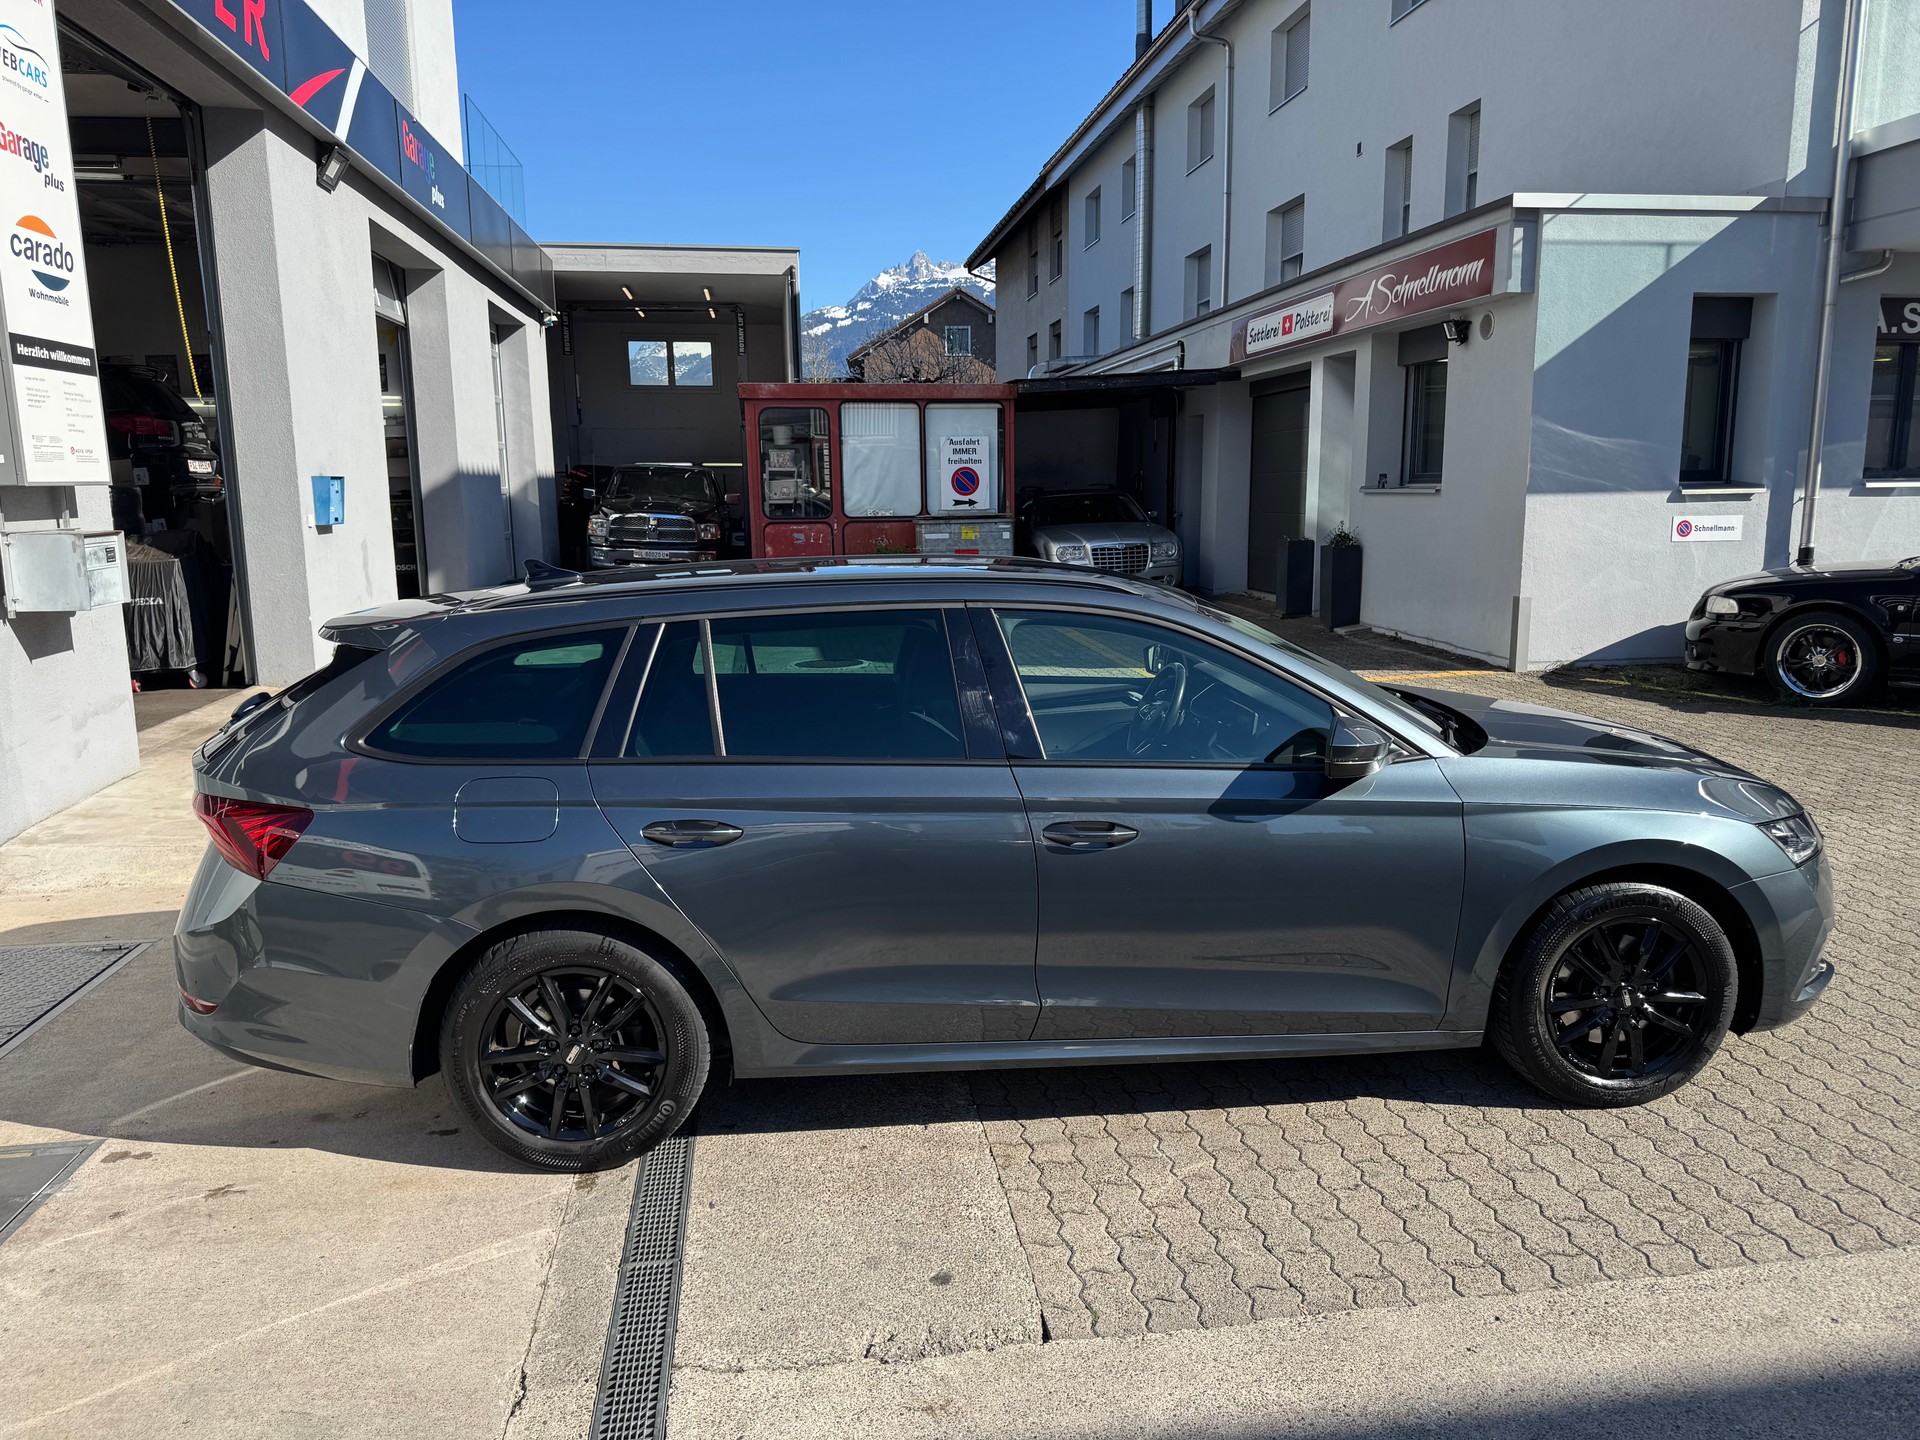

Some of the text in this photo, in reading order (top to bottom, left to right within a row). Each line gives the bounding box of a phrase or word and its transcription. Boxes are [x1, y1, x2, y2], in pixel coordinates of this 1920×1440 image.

[0, 46, 47, 88] EBCARS
[0, 121, 49, 174] Garage
[402, 119, 435, 185] Garage
[44, 172, 65, 192] plus
[431, 184, 444, 209] plus
[10, 233, 74, 273] carado
[28, 287, 70, 307] Wohnmobile
[1248, 304, 1332, 345] Sattlerei Polsterei
[16, 343, 91, 366] Herzlich willkommen
[949, 438, 980, 446] Ausfahrt
[948, 457, 982, 465] freihalten
[1694, 524, 1735, 532] Schnellmann
